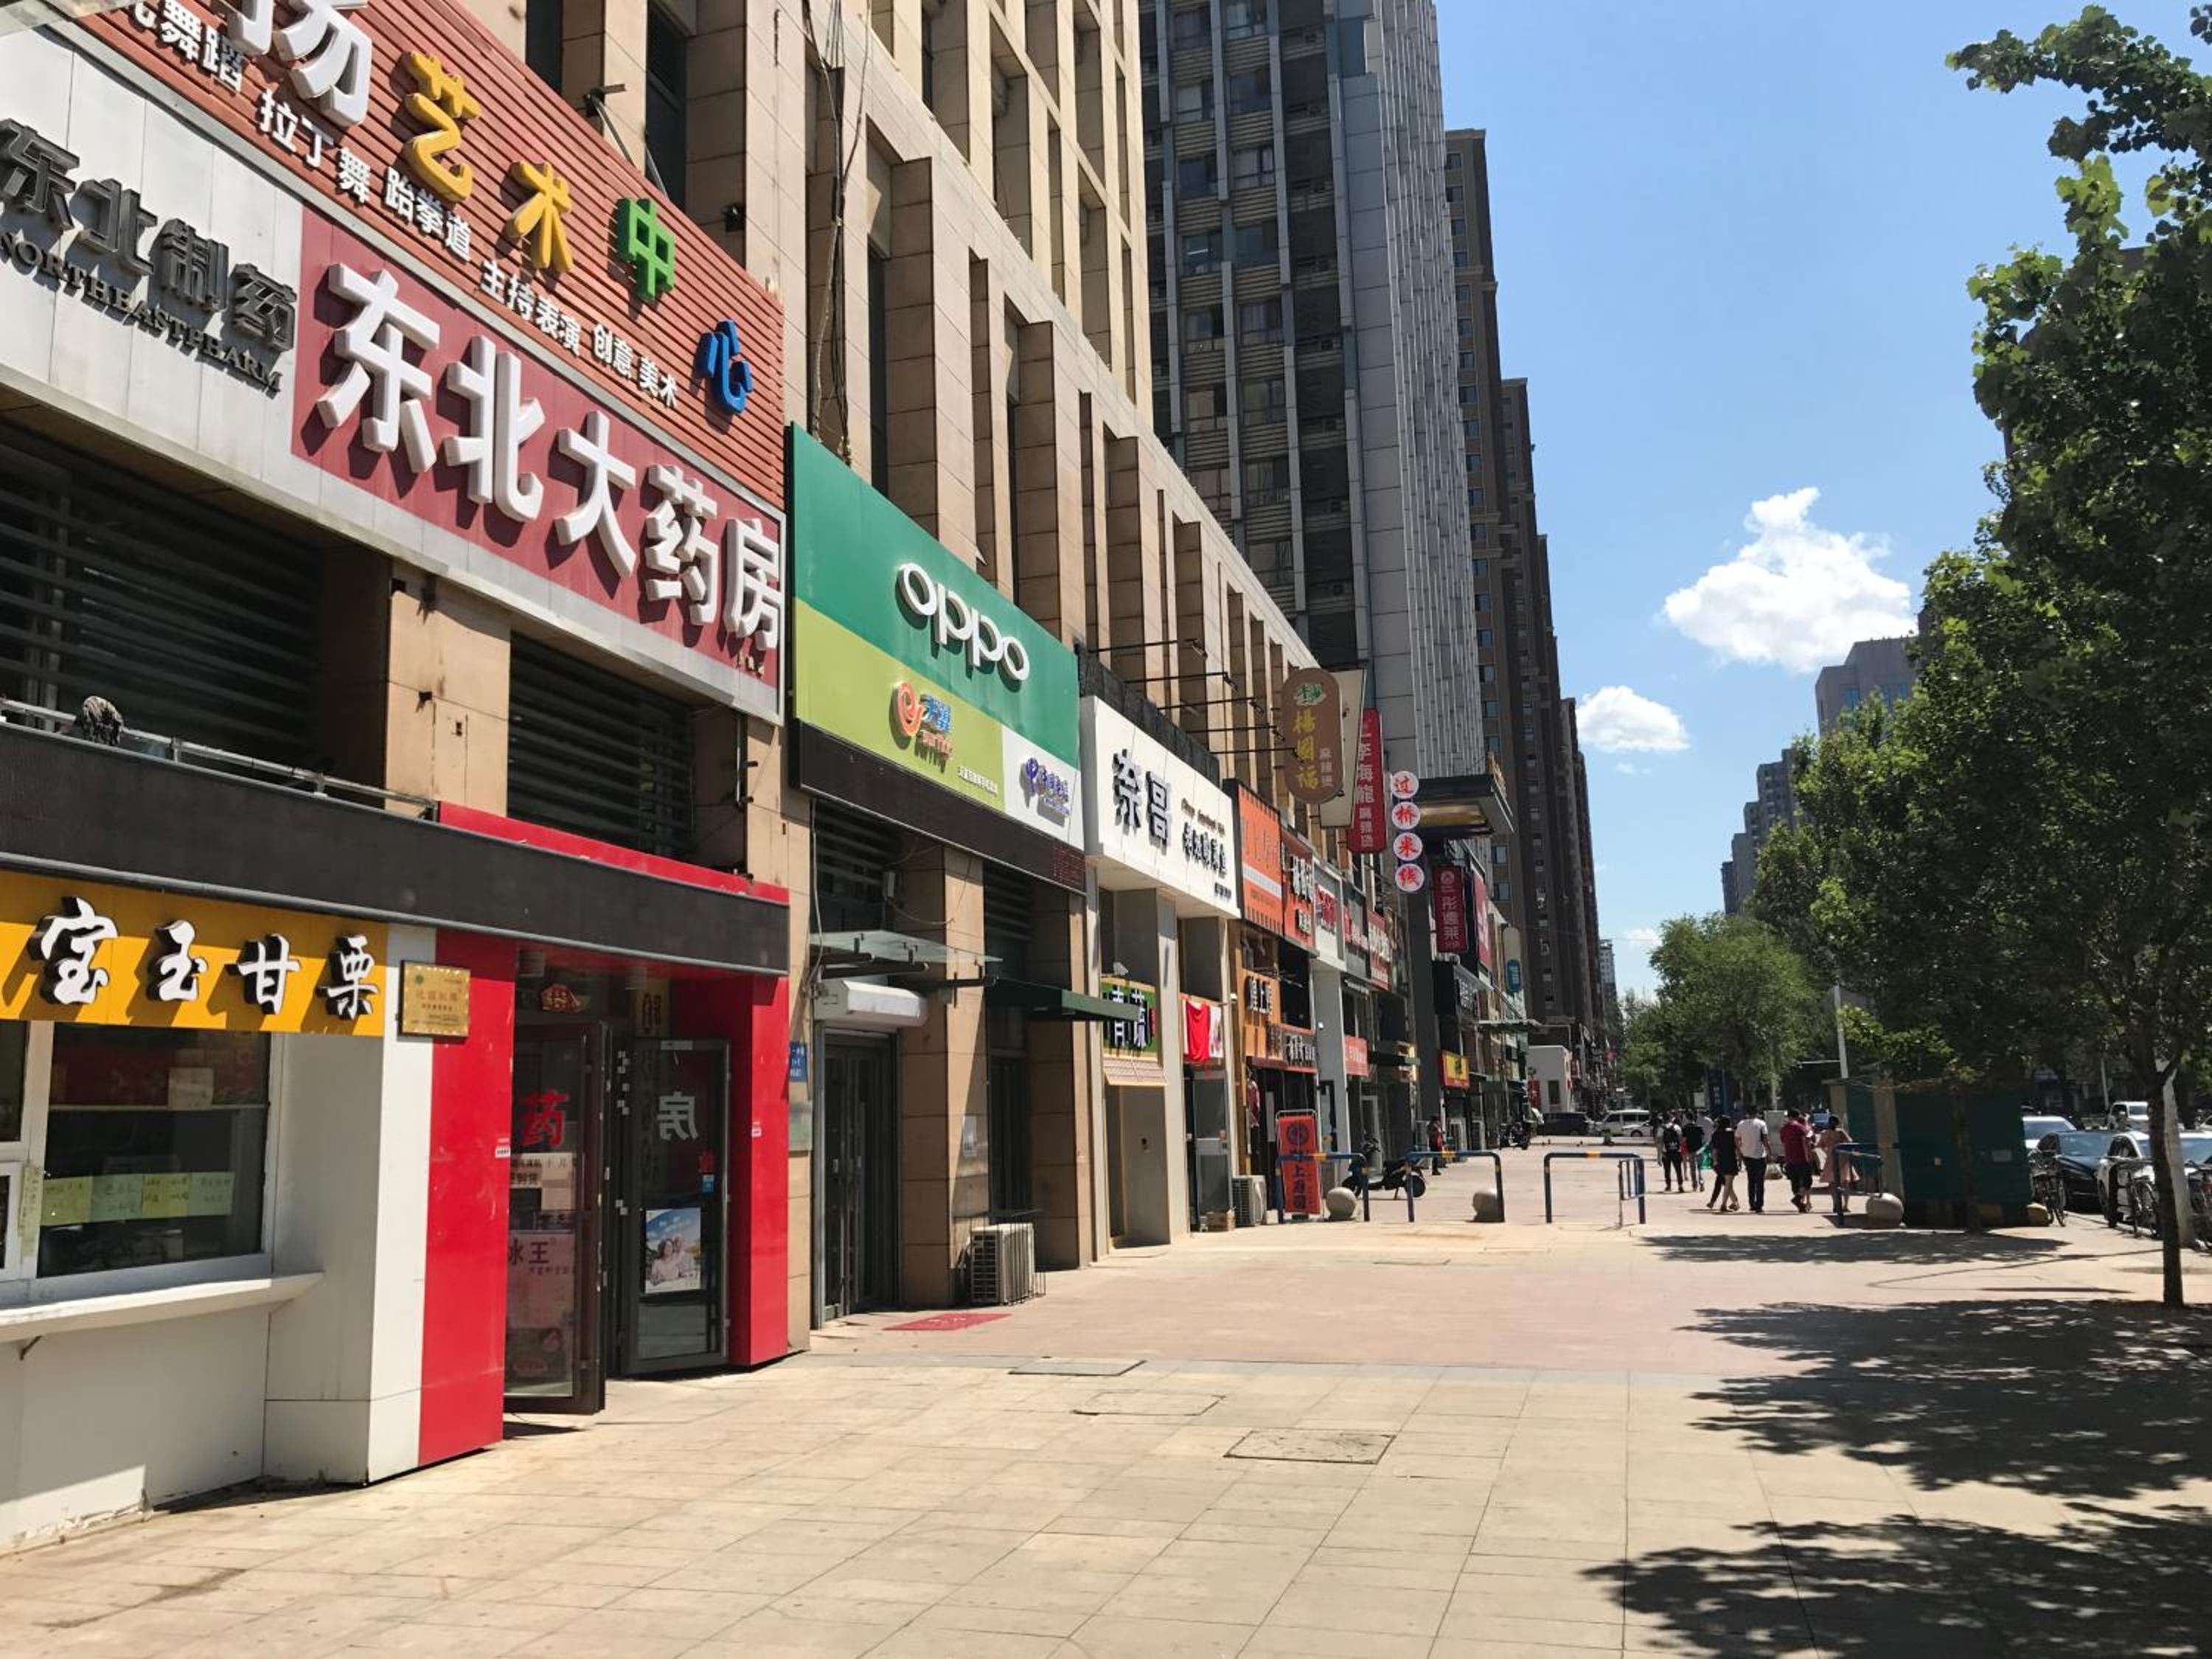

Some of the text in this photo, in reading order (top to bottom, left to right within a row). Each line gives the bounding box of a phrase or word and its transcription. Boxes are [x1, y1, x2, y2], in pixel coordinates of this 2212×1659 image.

[384, 166, 472, 262] 跆拳道
[480, 258, 581, 357] 主持表演
[316, 264, 779, 650] 东北大药房
[29, 897, 380, 1021] 宝玉甘栗
[519, 1089, 570, 1147] 药
